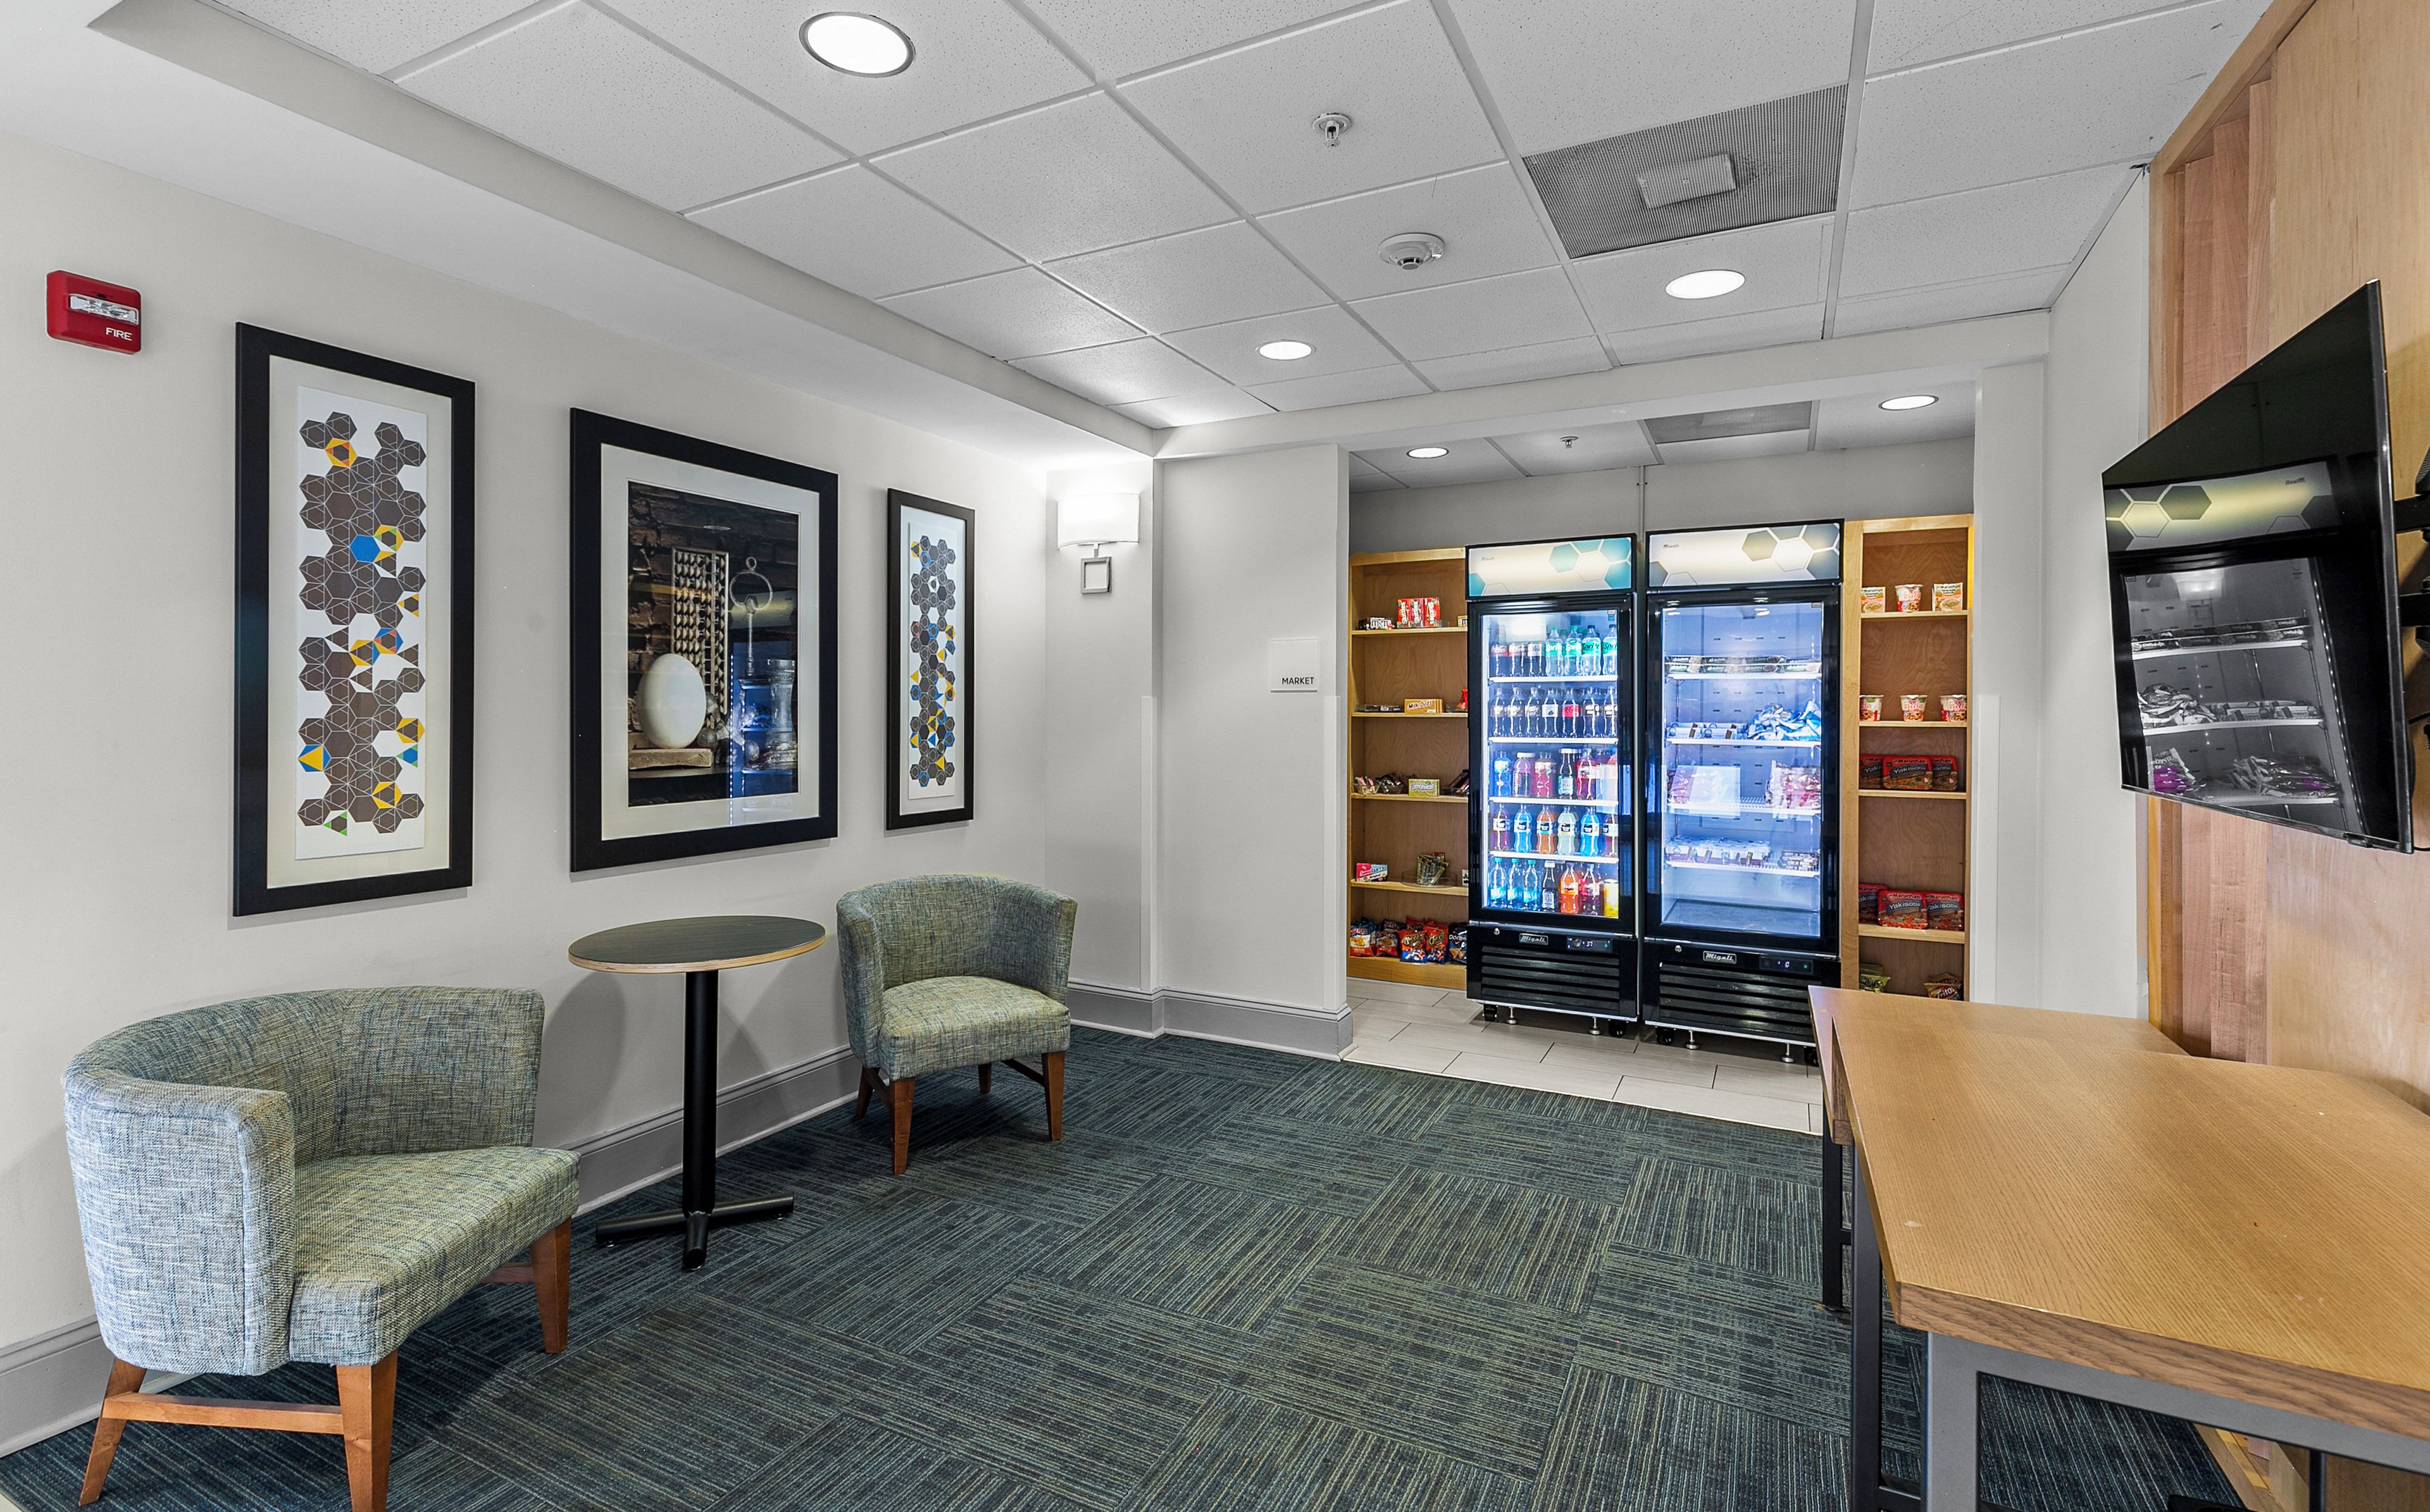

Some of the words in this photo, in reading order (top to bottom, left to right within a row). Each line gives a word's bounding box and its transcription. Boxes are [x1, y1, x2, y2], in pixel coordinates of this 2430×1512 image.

[106, 327, 132, 341] FIRE
[1893, 765, 1926, 774] Yakisoba
[1889, 902, 1921, 910] Yakisoba
[1521, 934, 1546, 943] Migali
[1705, 952, 1735, 962] Migali
